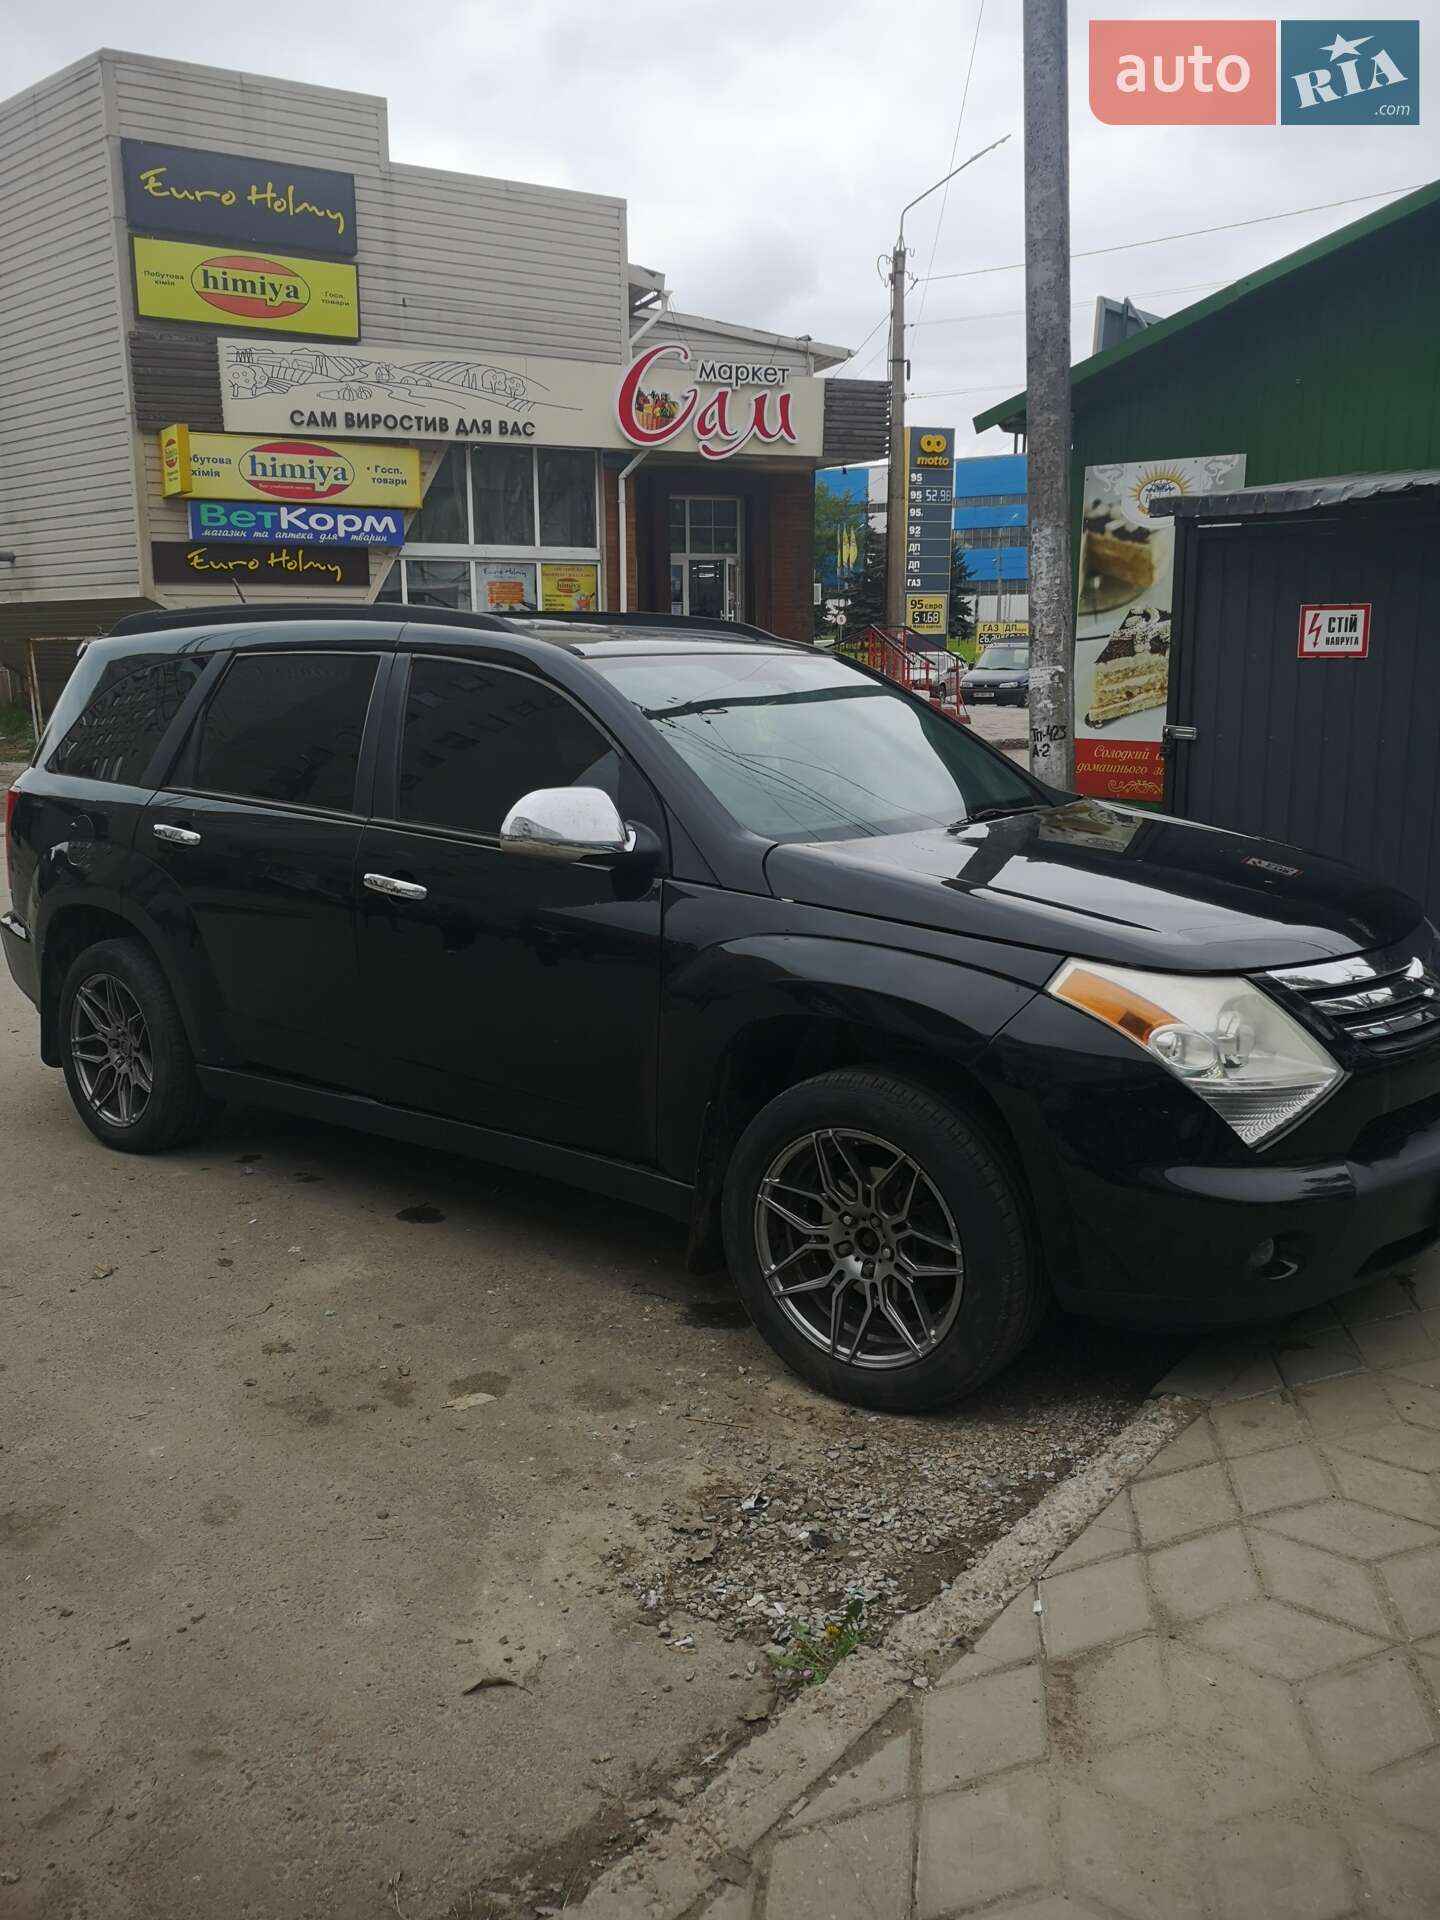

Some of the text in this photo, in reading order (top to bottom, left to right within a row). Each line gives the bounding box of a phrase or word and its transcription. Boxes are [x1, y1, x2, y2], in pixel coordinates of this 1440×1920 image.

[139, 167, 345, 235] Euro Holmy
[201, 268, 300, 302] himiya
[618, 345, 797, 457] Сам
[289, 409, 536, 437] САМ ВИРОСТИВ ДЛЯ ВАС
[190, 454, 232, 465] бутова
[916, 456, 949, 466] motto
[192, 468, 220, 477] хімія
[248, 453, 348, 486] himiya
[374, 465, 403, 475] Госп.
[371, 476, 407, 487] товари
[910, 473, 923, 482] 95
[910, 490, 922, 499] 95
[200, 503, 397, 537] ВетКорм
[201, 528, 388, 544] магазин та аптека для тварин
[909, 526, 921, 535] 92
[908, 543, 921, 552] ДП
[187, 547, 342, 582] Euro Holmy
[908, 560, 920, 570] ДП
[907, 578, 921, 587] ГАЗ
[910, 599, 924, 609] 95
[982, 624, 999, 632] ГАЗ
[1004, 624, 1017, 633] ДП
[1327, 614, 1358, 633] СТІЙ
[1325, 636, 1359, 646] НАПРУГА
[1093, 744, 1150, 763] Солодкий
[1075, 761, 1148, 775] домашнього
